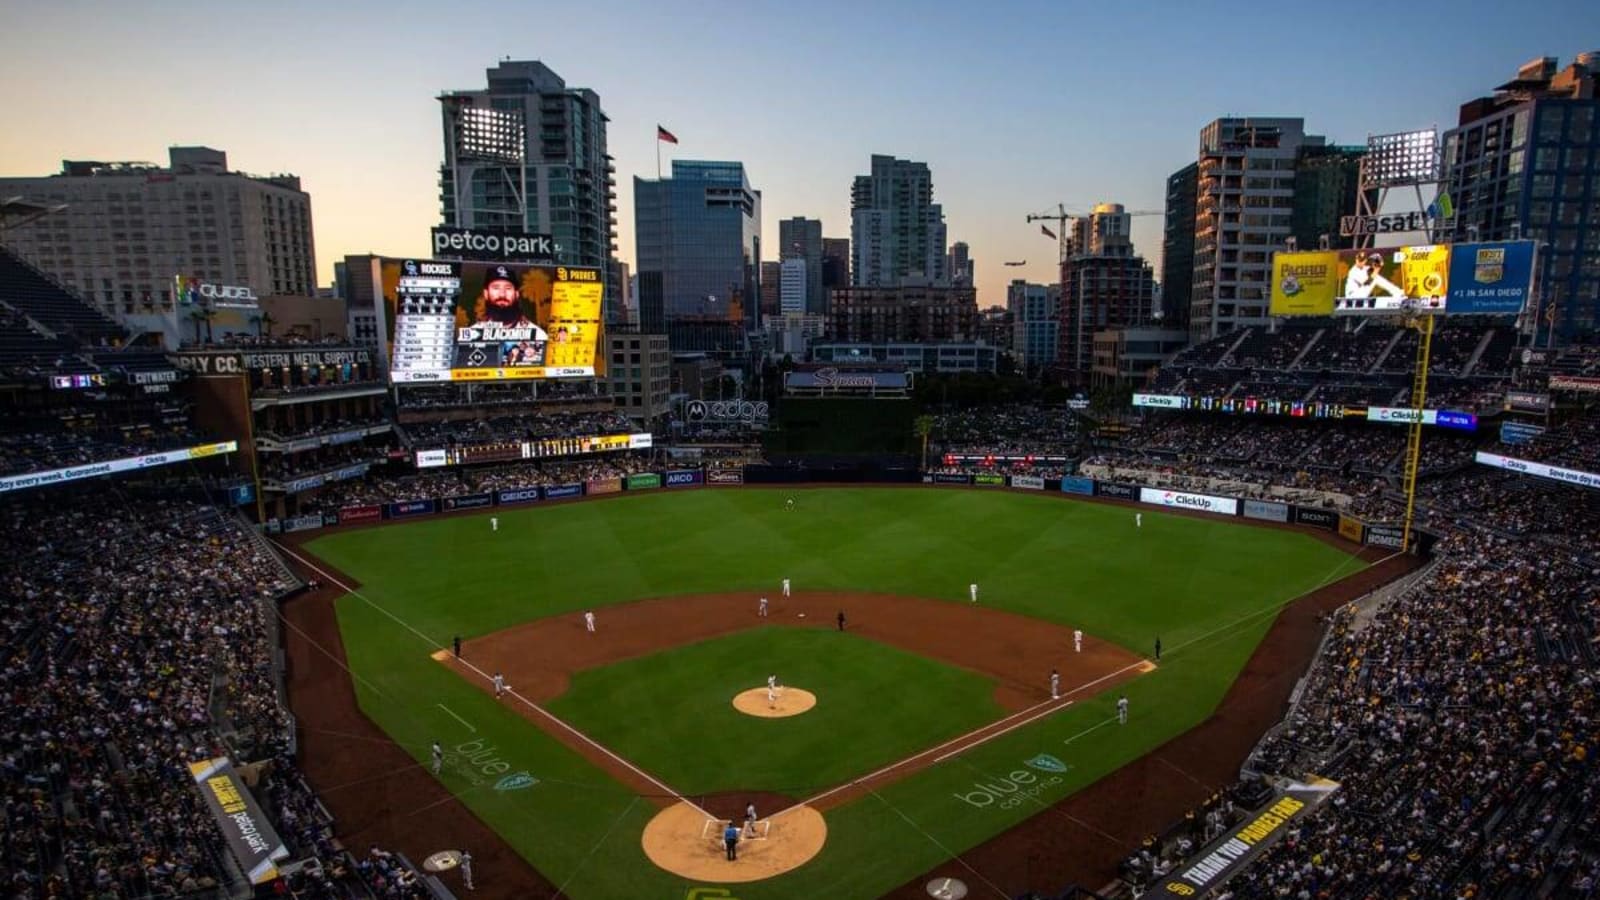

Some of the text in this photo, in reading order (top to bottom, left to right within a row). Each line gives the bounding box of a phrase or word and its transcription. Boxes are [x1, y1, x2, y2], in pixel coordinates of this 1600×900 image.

[1341, 211, 1417, 234] Viasat
[434, 230, 552, 256] petco park
[421, 263, 452, 275] ROCKIES
[570, 271, 596, 280] PADRES
[200, 283, 258, 300] QUIDEL
[1453, 288, 1522, 297] #1 IN SAN DIEGO
[462, 329, 471, 339] 19
[482, 328, 532, 341] BLACKMON
[242, 351, 370, 369] WESTERN METAL SUPPLY CO.
[136, 371, 175, 383] CUTWATER
[412, 372, 439, 380] ClickUp
[712, 399, 769, 424] edge
[15, 476, 39, 486] every
[668, 474, 693, 483] ARCO
[501, 490, 537, 502] GEICO
[1175, 495, 1212, 509] ClickUp
[456, 738, 511, 775] blue
[952, 770, 1037, 808] blue
[1181, 796, 1305, 887] THANK YOU PADRES FANS
